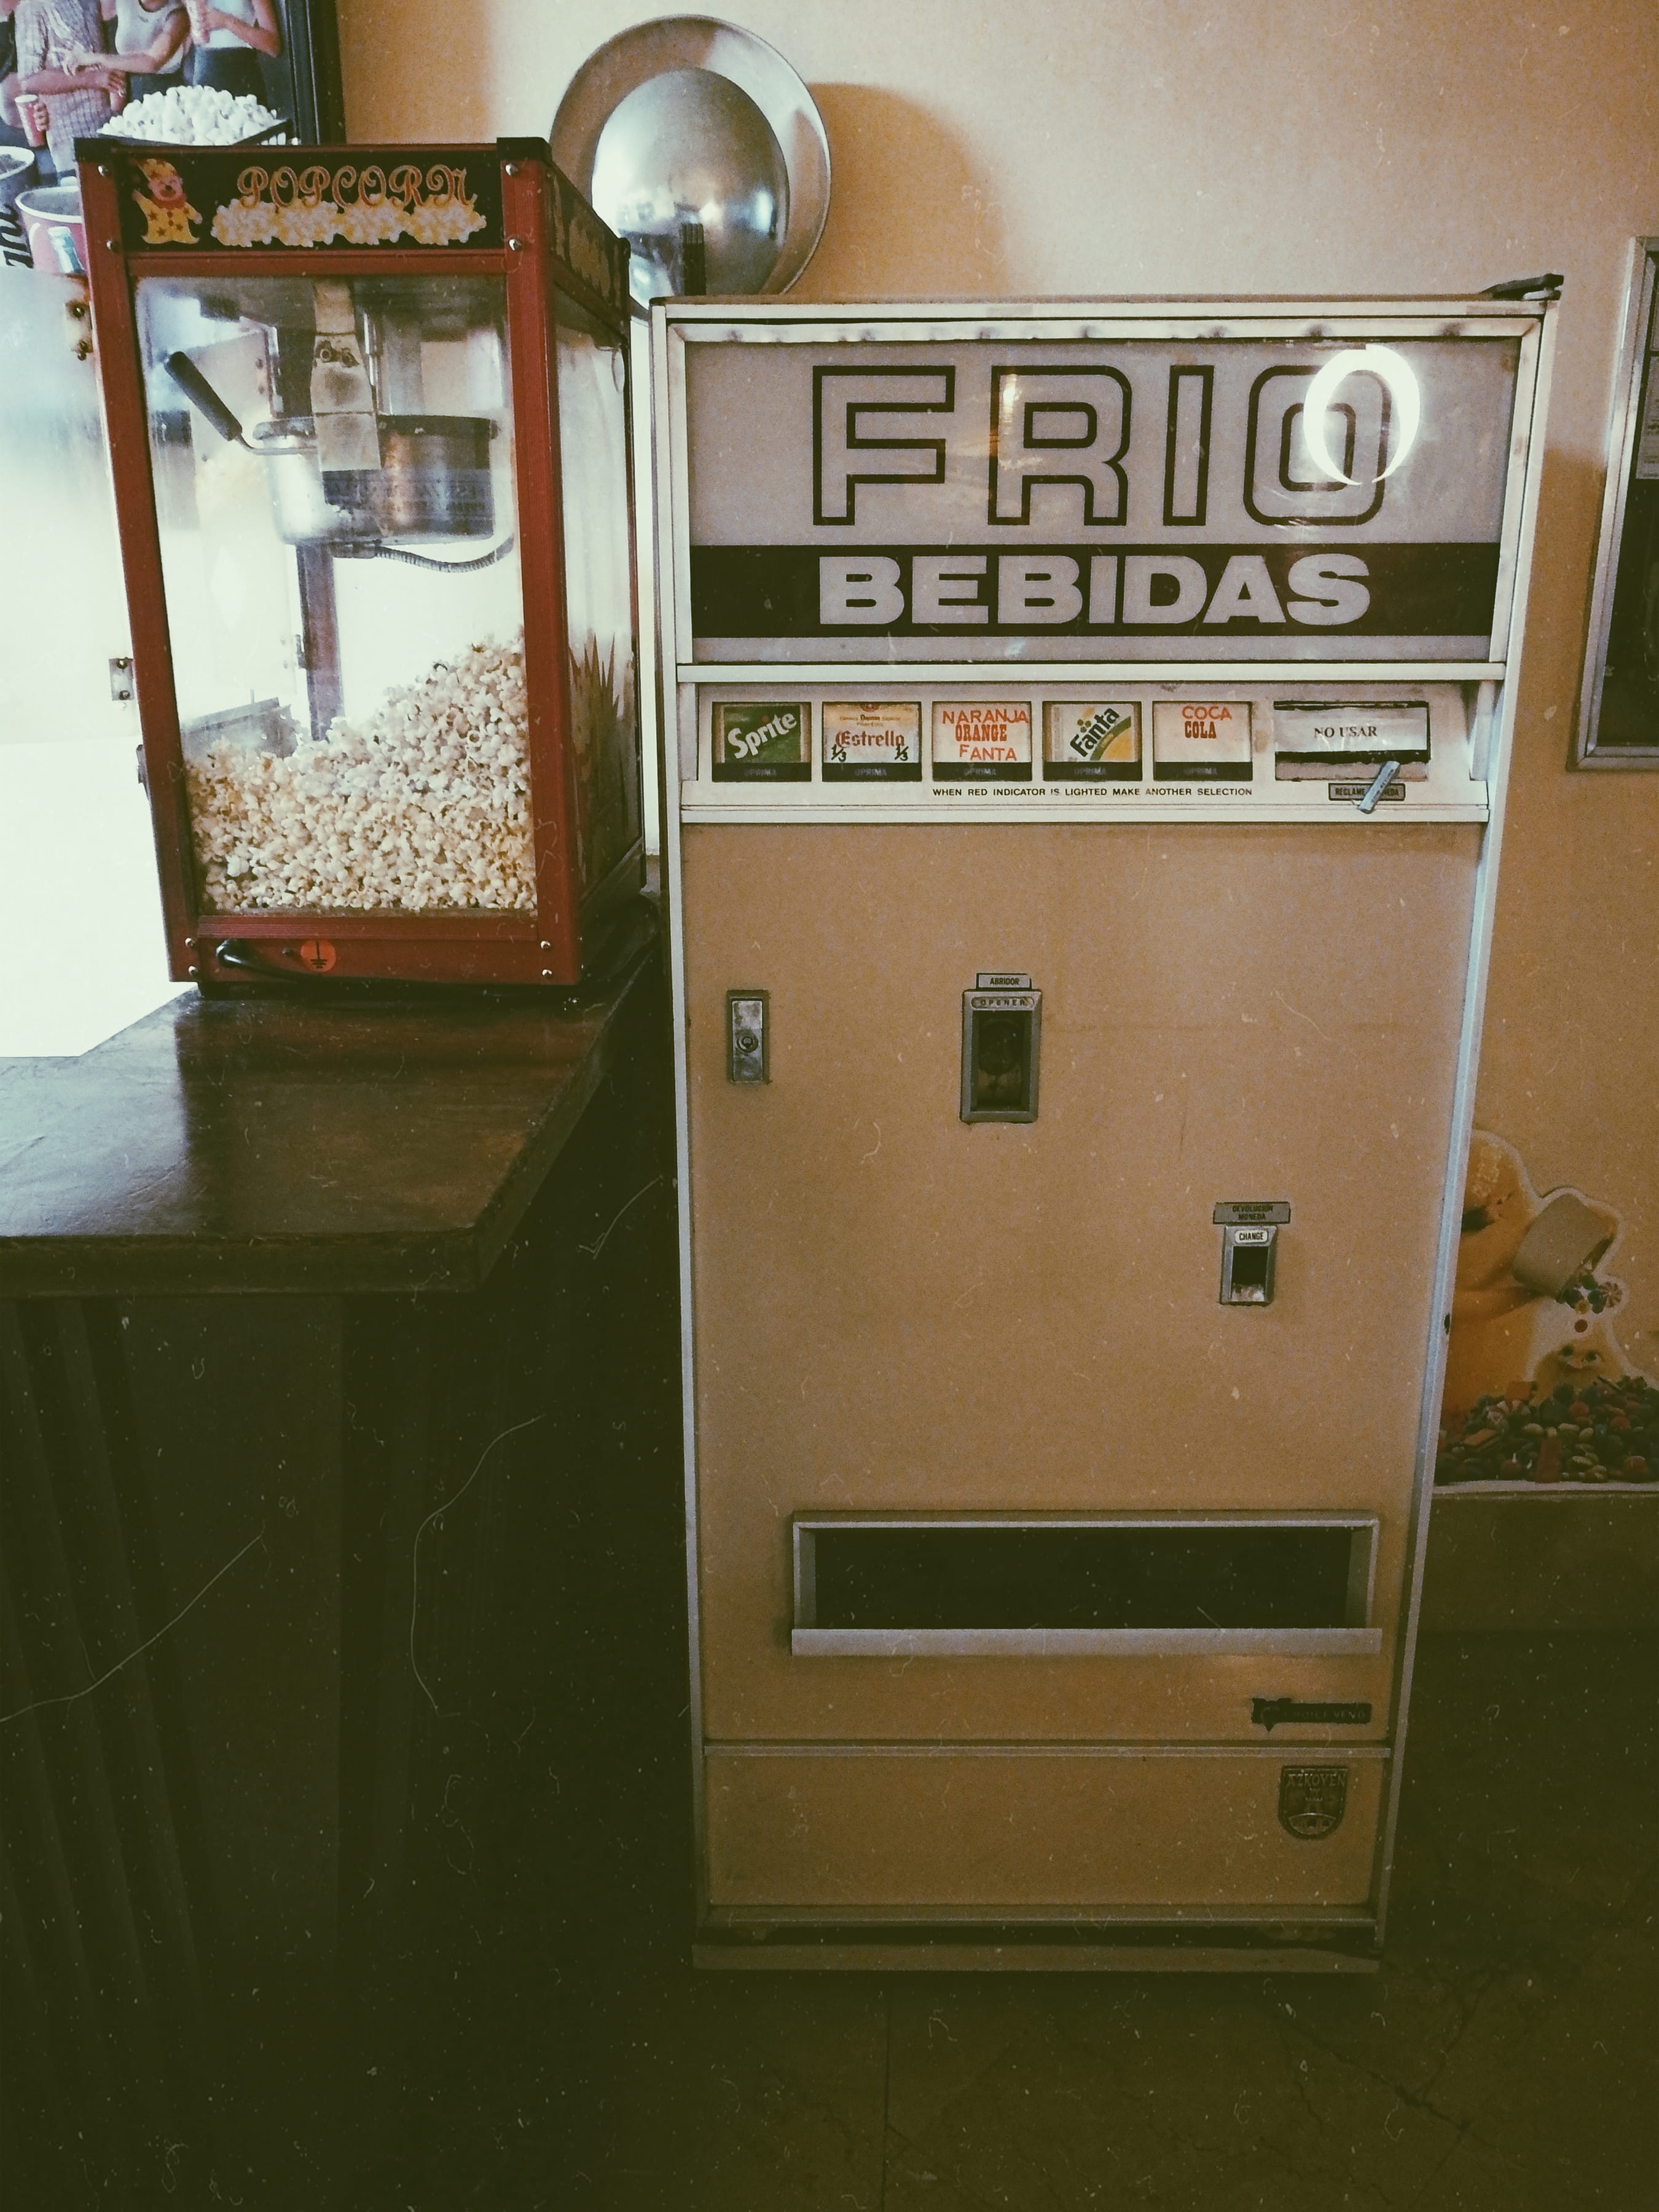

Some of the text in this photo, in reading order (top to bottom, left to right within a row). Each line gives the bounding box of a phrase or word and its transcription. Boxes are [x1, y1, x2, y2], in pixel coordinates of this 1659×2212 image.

[237, 164, 478, 210] POPCORN
[812, 364, 1392, 527] FRIO
[818, 553, 1370, 625] BEBIDAS
[942, 709, 1029, 724] NARANJA
[1182, 705, 1233, 720] COCA
[728, 713, 797, 759] Sprite
[836, 729, 905, 748] Estrella
[955, 724, 1008, 742] ORANGE
[1070, 708, 1120, 757] Fanta
[1185, 721, 1217, 739] COLA
[1314, 726, 1378, 738] NO USAR
[959, 744, 1017, 761] FANTA
[1239, 1232, 1264, 1241] CHANGE
